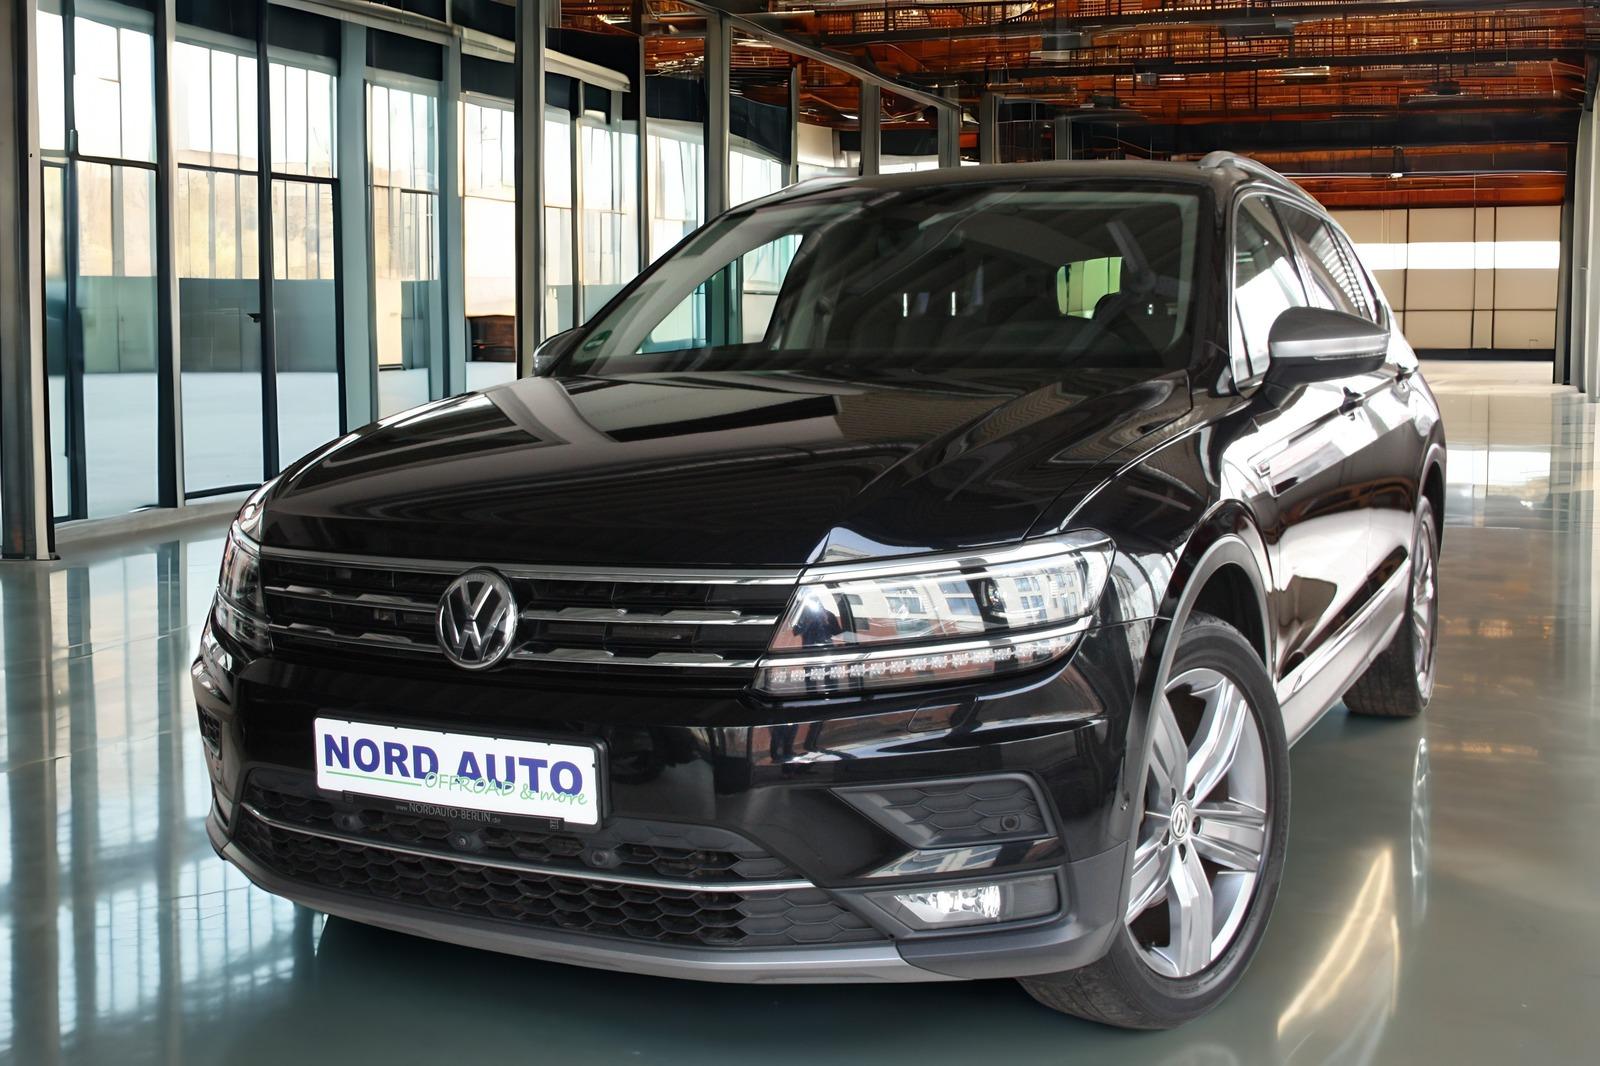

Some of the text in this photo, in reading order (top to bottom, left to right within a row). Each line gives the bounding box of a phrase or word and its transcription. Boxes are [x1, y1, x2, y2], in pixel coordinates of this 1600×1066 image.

[323, 733, 584, 796] NORD AUTO
[424, 771, 588, 806] OFFROAD & more
